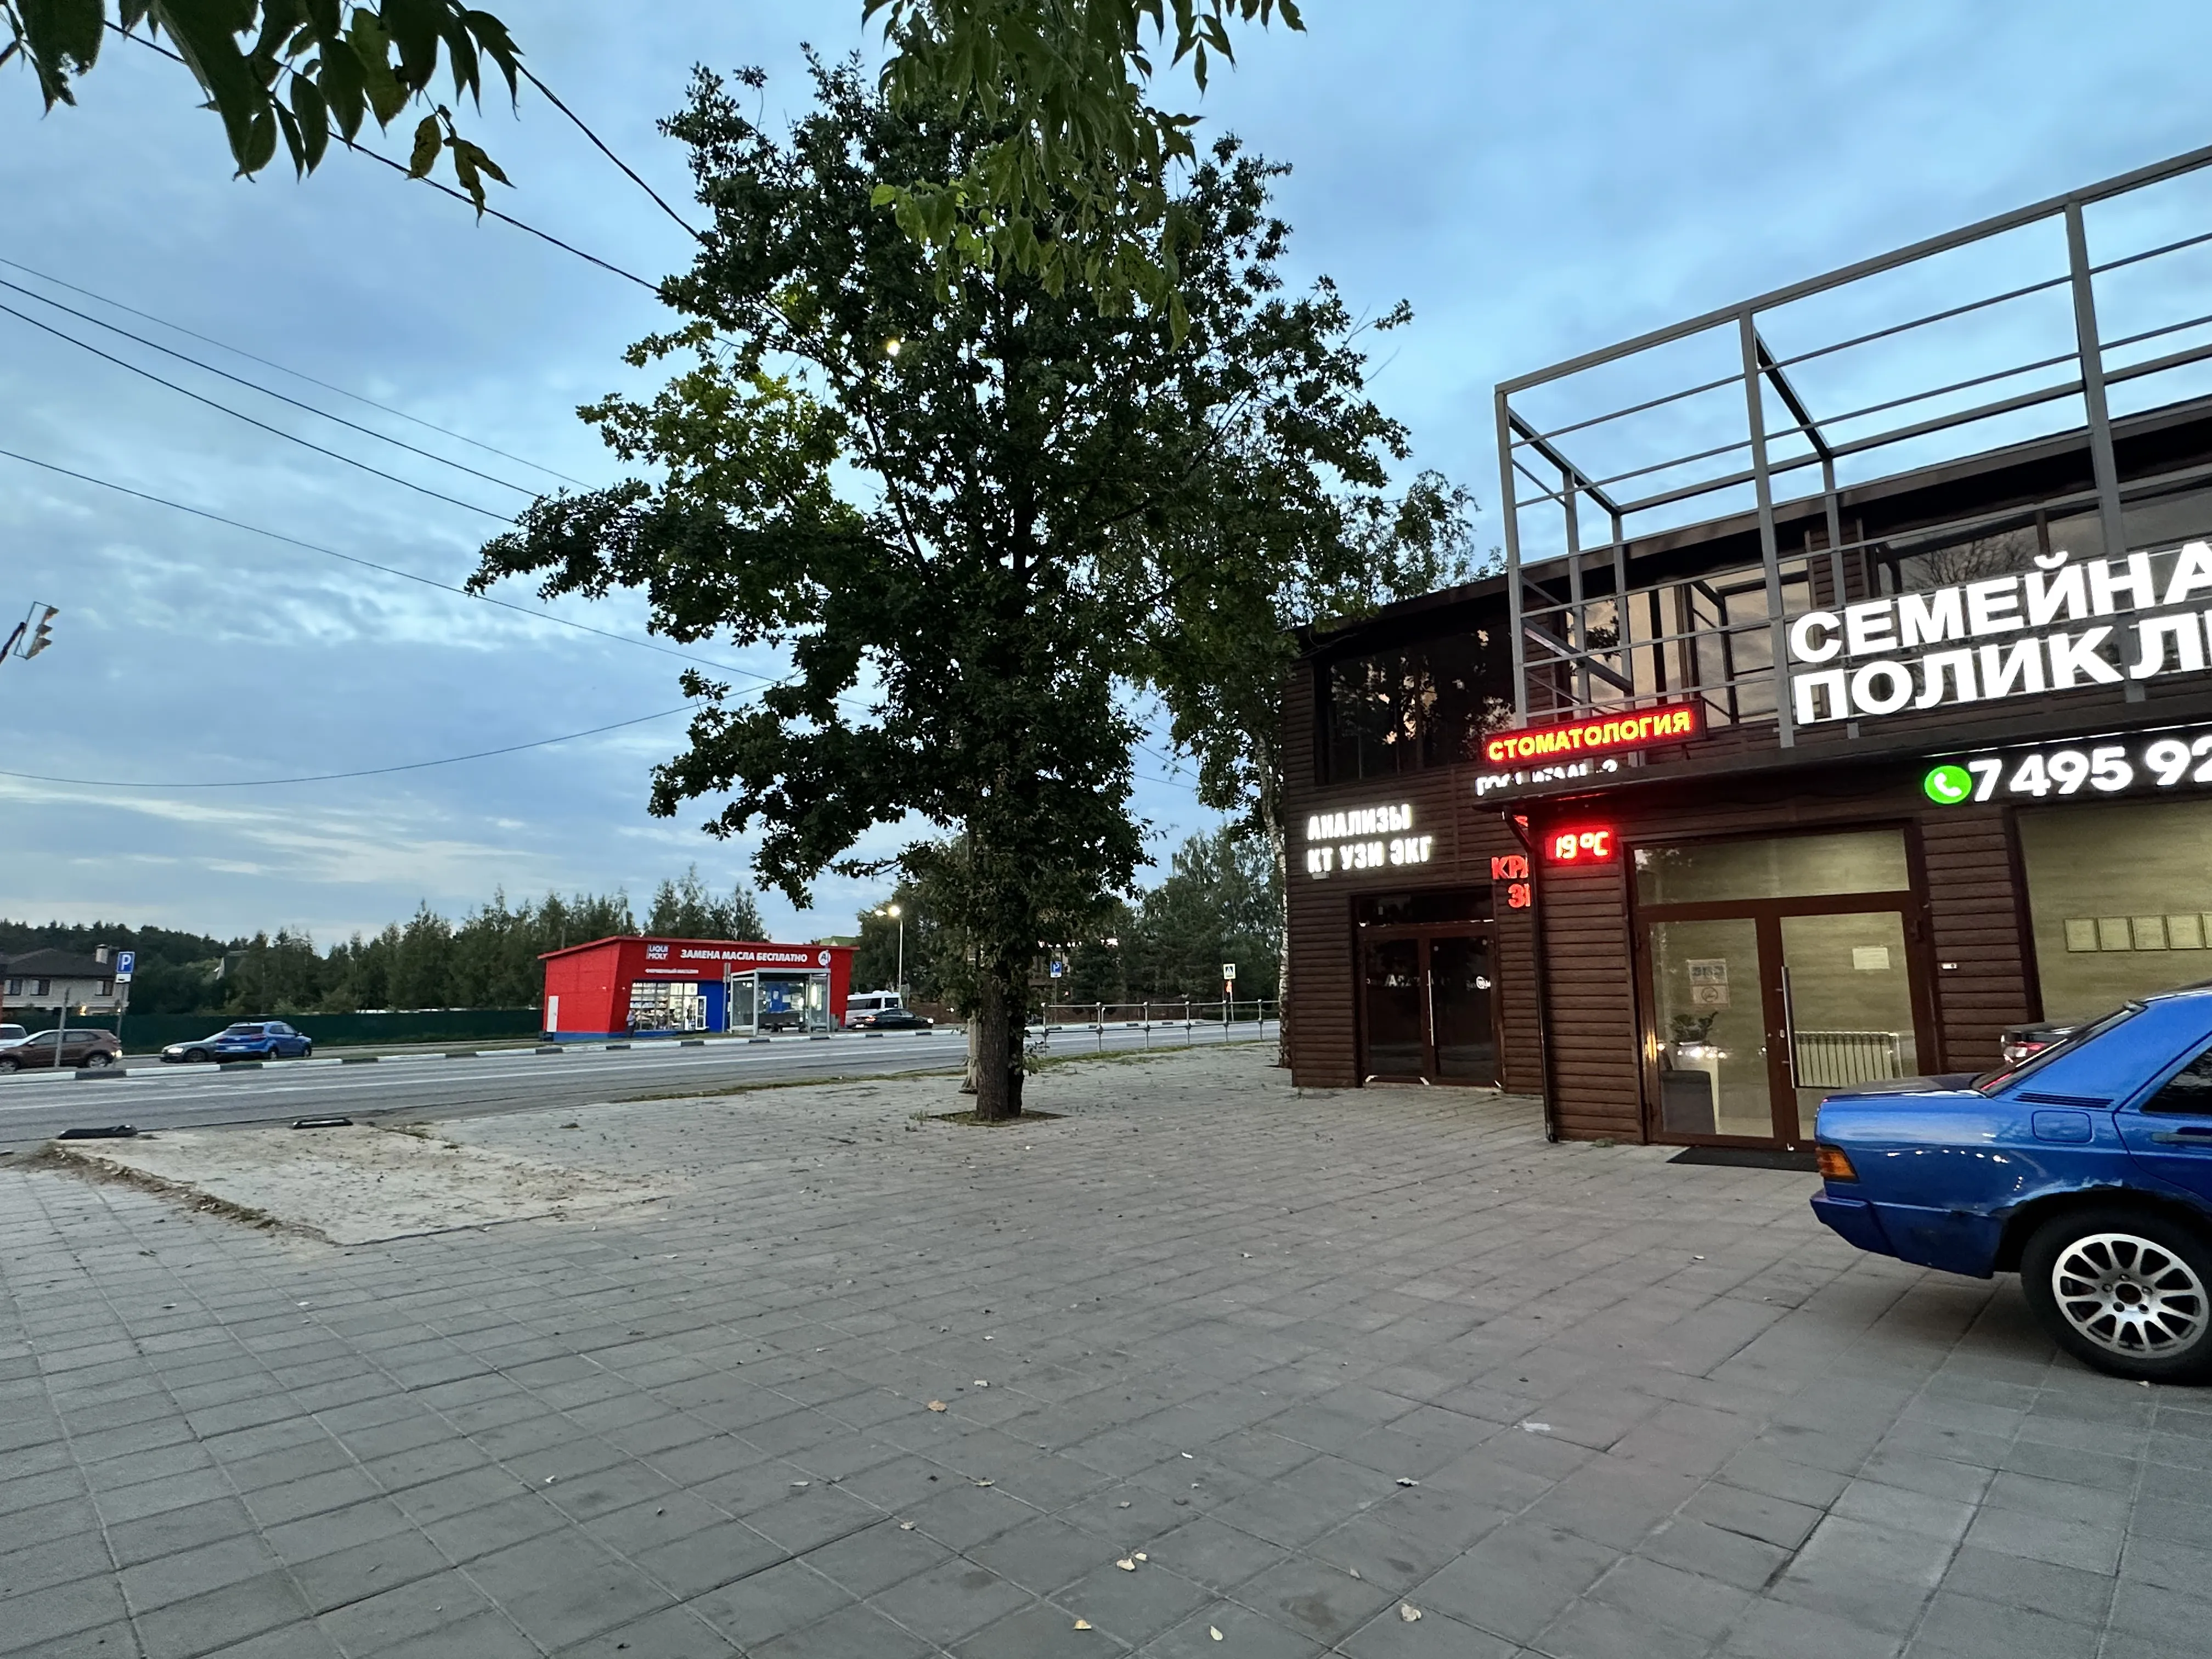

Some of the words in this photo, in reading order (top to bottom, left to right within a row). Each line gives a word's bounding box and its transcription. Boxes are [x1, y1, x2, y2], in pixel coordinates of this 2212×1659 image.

[1793, 610, 2212, 725] ПОЛИКЛ
[1488, 711, 1691, 760] СТОМАТОЛОГИЯ
[1967, 758, 2002, 802] 7
[2010, 746, 2134, 797] 495
[1307, 803, 1412, 840] АНАЛИЗЫ
[1307, 847, 1334, 873] КТ
[1339, 840, 1385, 871] УЗИ
[1390, 835, 1432, 866] ЭКГ
[121, 954, 132, 970] P
[680, 949, 720, 960] ЗАМЕНА
[721, 951, 755, 961] МАСЛА
[756, 952, 808, 962] БЕСПЛАТНО
